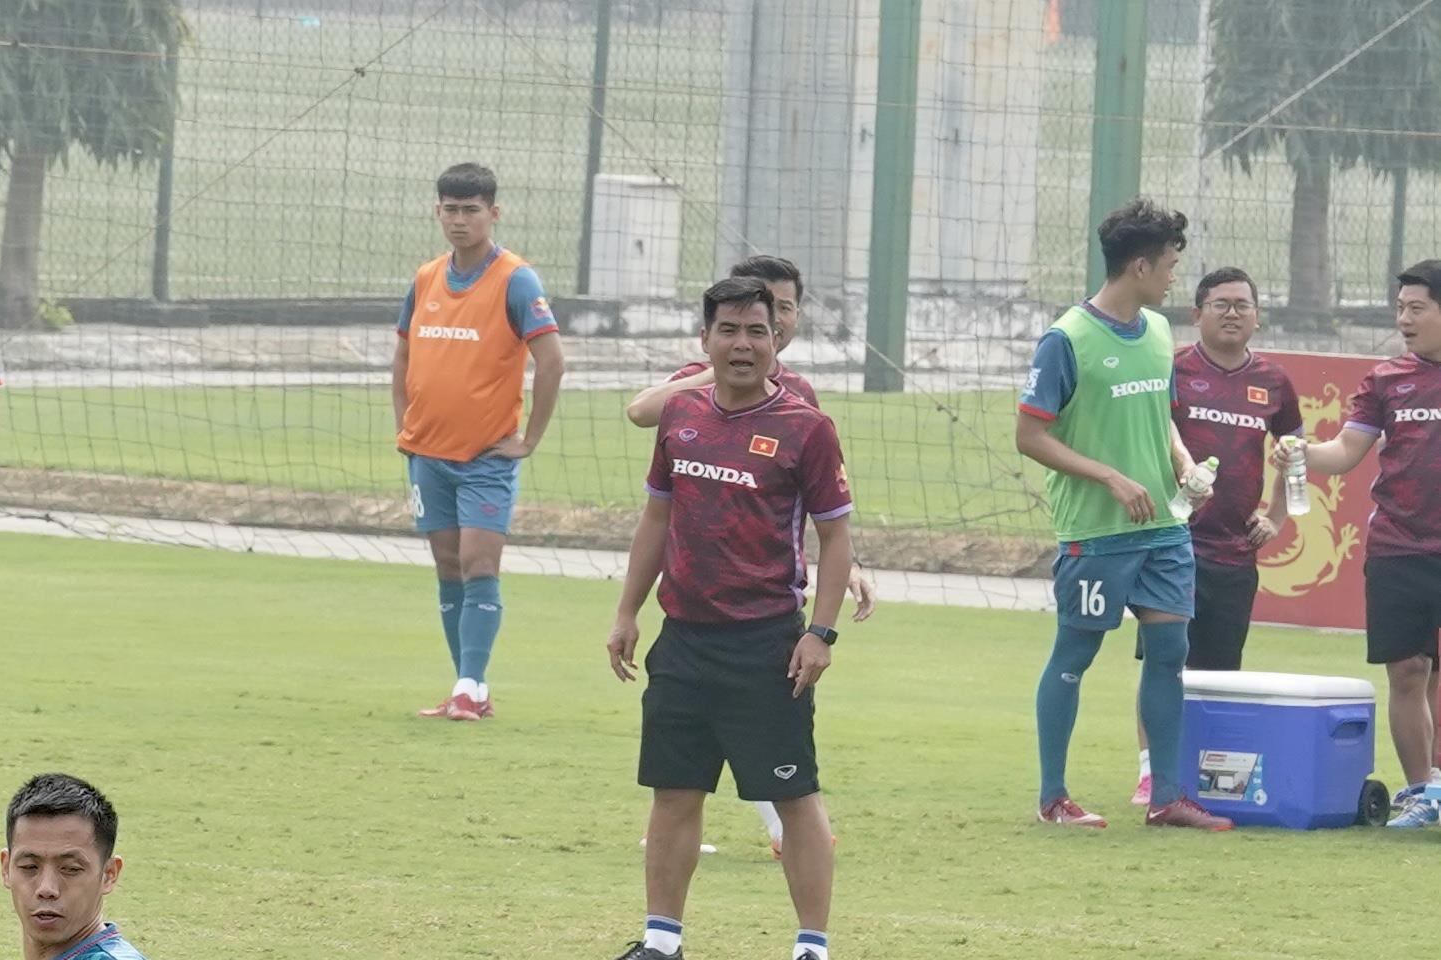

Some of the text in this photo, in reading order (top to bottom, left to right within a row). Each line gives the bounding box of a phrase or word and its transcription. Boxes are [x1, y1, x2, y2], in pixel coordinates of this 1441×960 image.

[417, 325, 480, 342] HONDA
[1188, 406, 1267, 431] HONDA
[1394, 408, 1441, 422] HON
[671, 458, 758, 489] HONDA
[1078, 579, 1106, 616] 16
